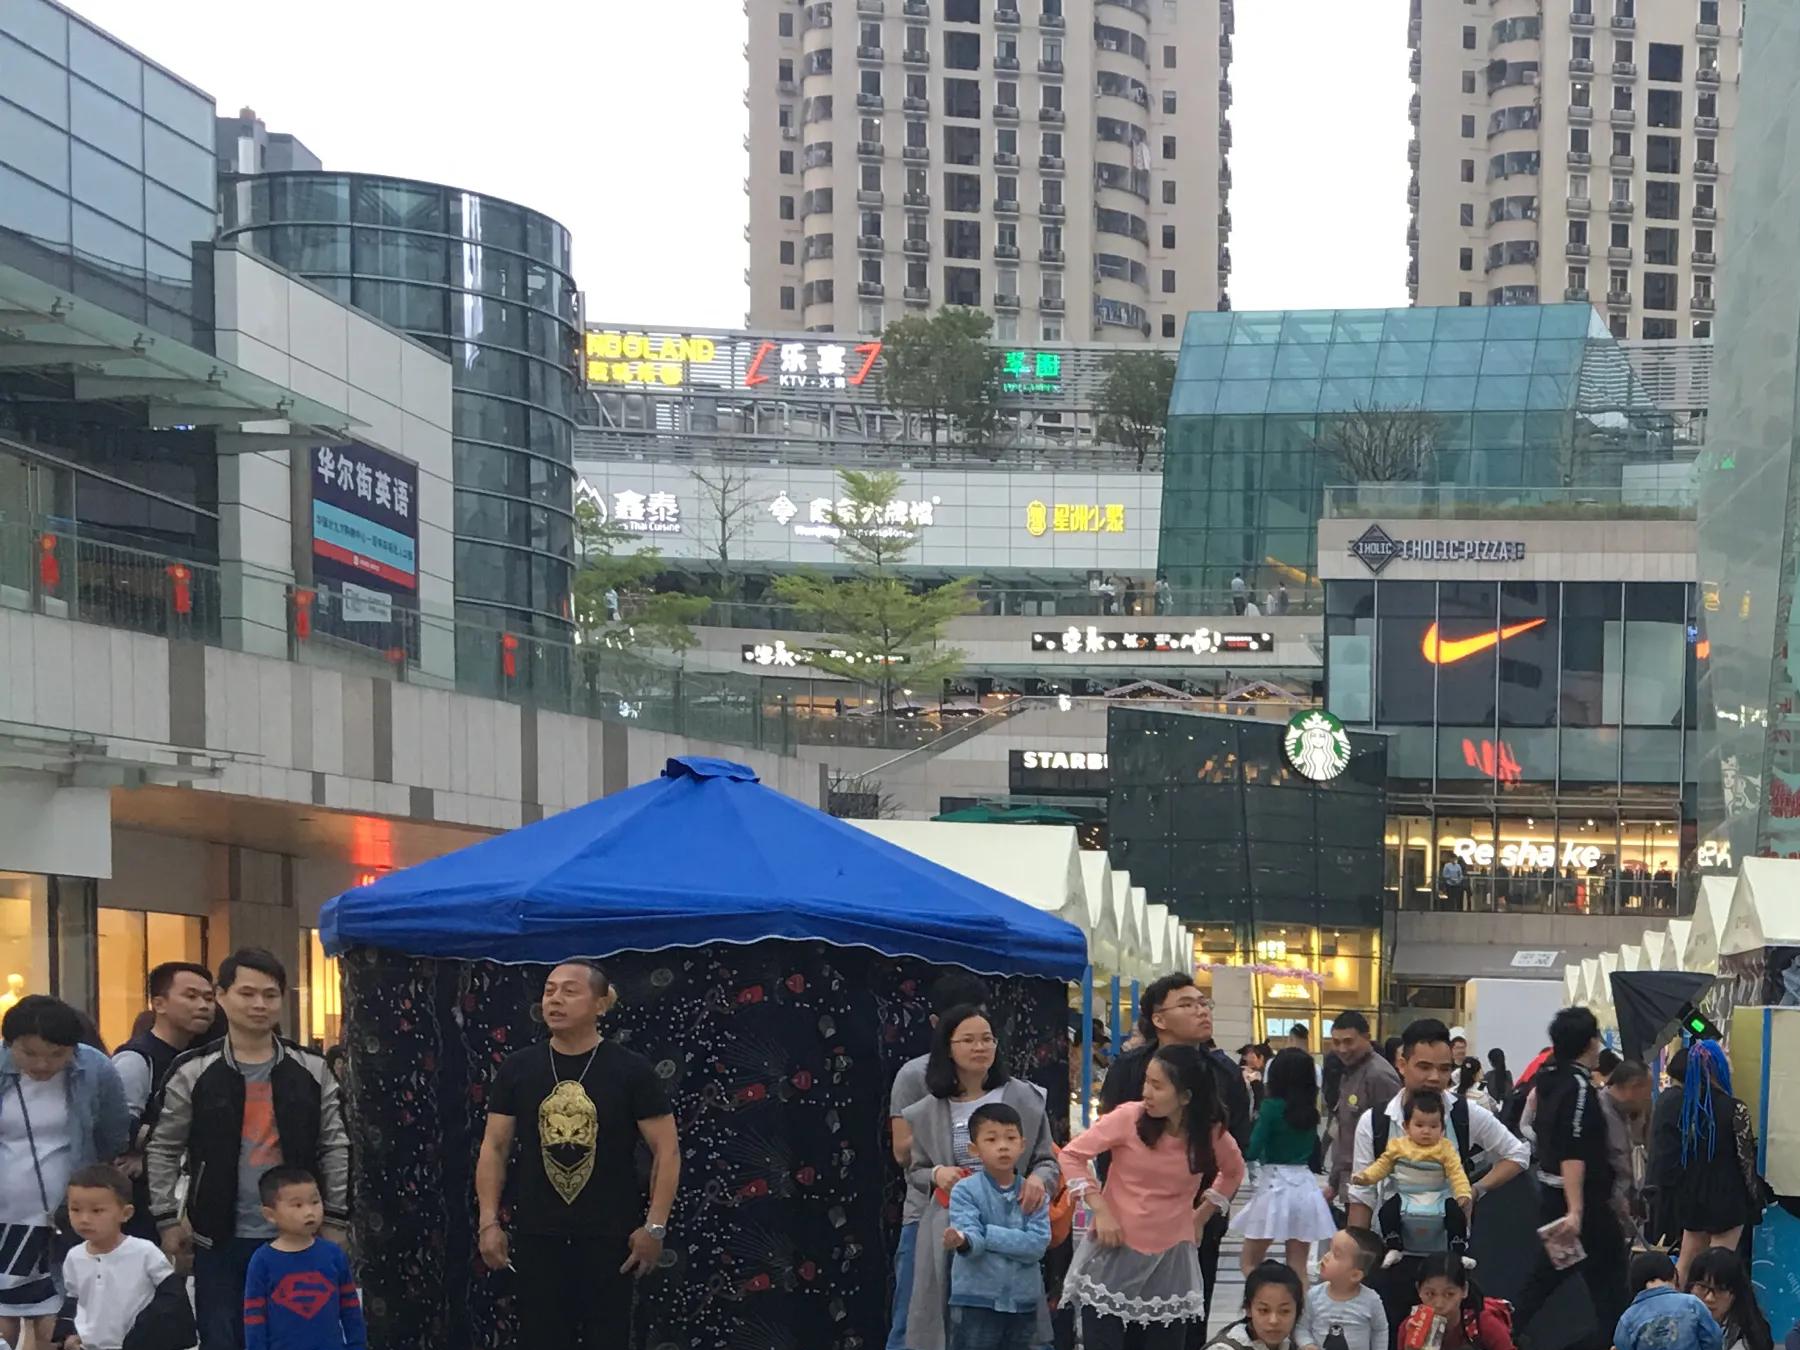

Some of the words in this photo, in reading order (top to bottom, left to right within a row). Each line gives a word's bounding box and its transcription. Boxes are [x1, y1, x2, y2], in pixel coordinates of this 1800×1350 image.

[317, 446, 410, 519] 华尔街英语
[613, 489, 680, 522] 鑫泰
[1412, 539, 1460, 560] HOLIC
[1463, 540, 1509, 561] PIZZA
[1023, 751, 1108, 770] STARB
